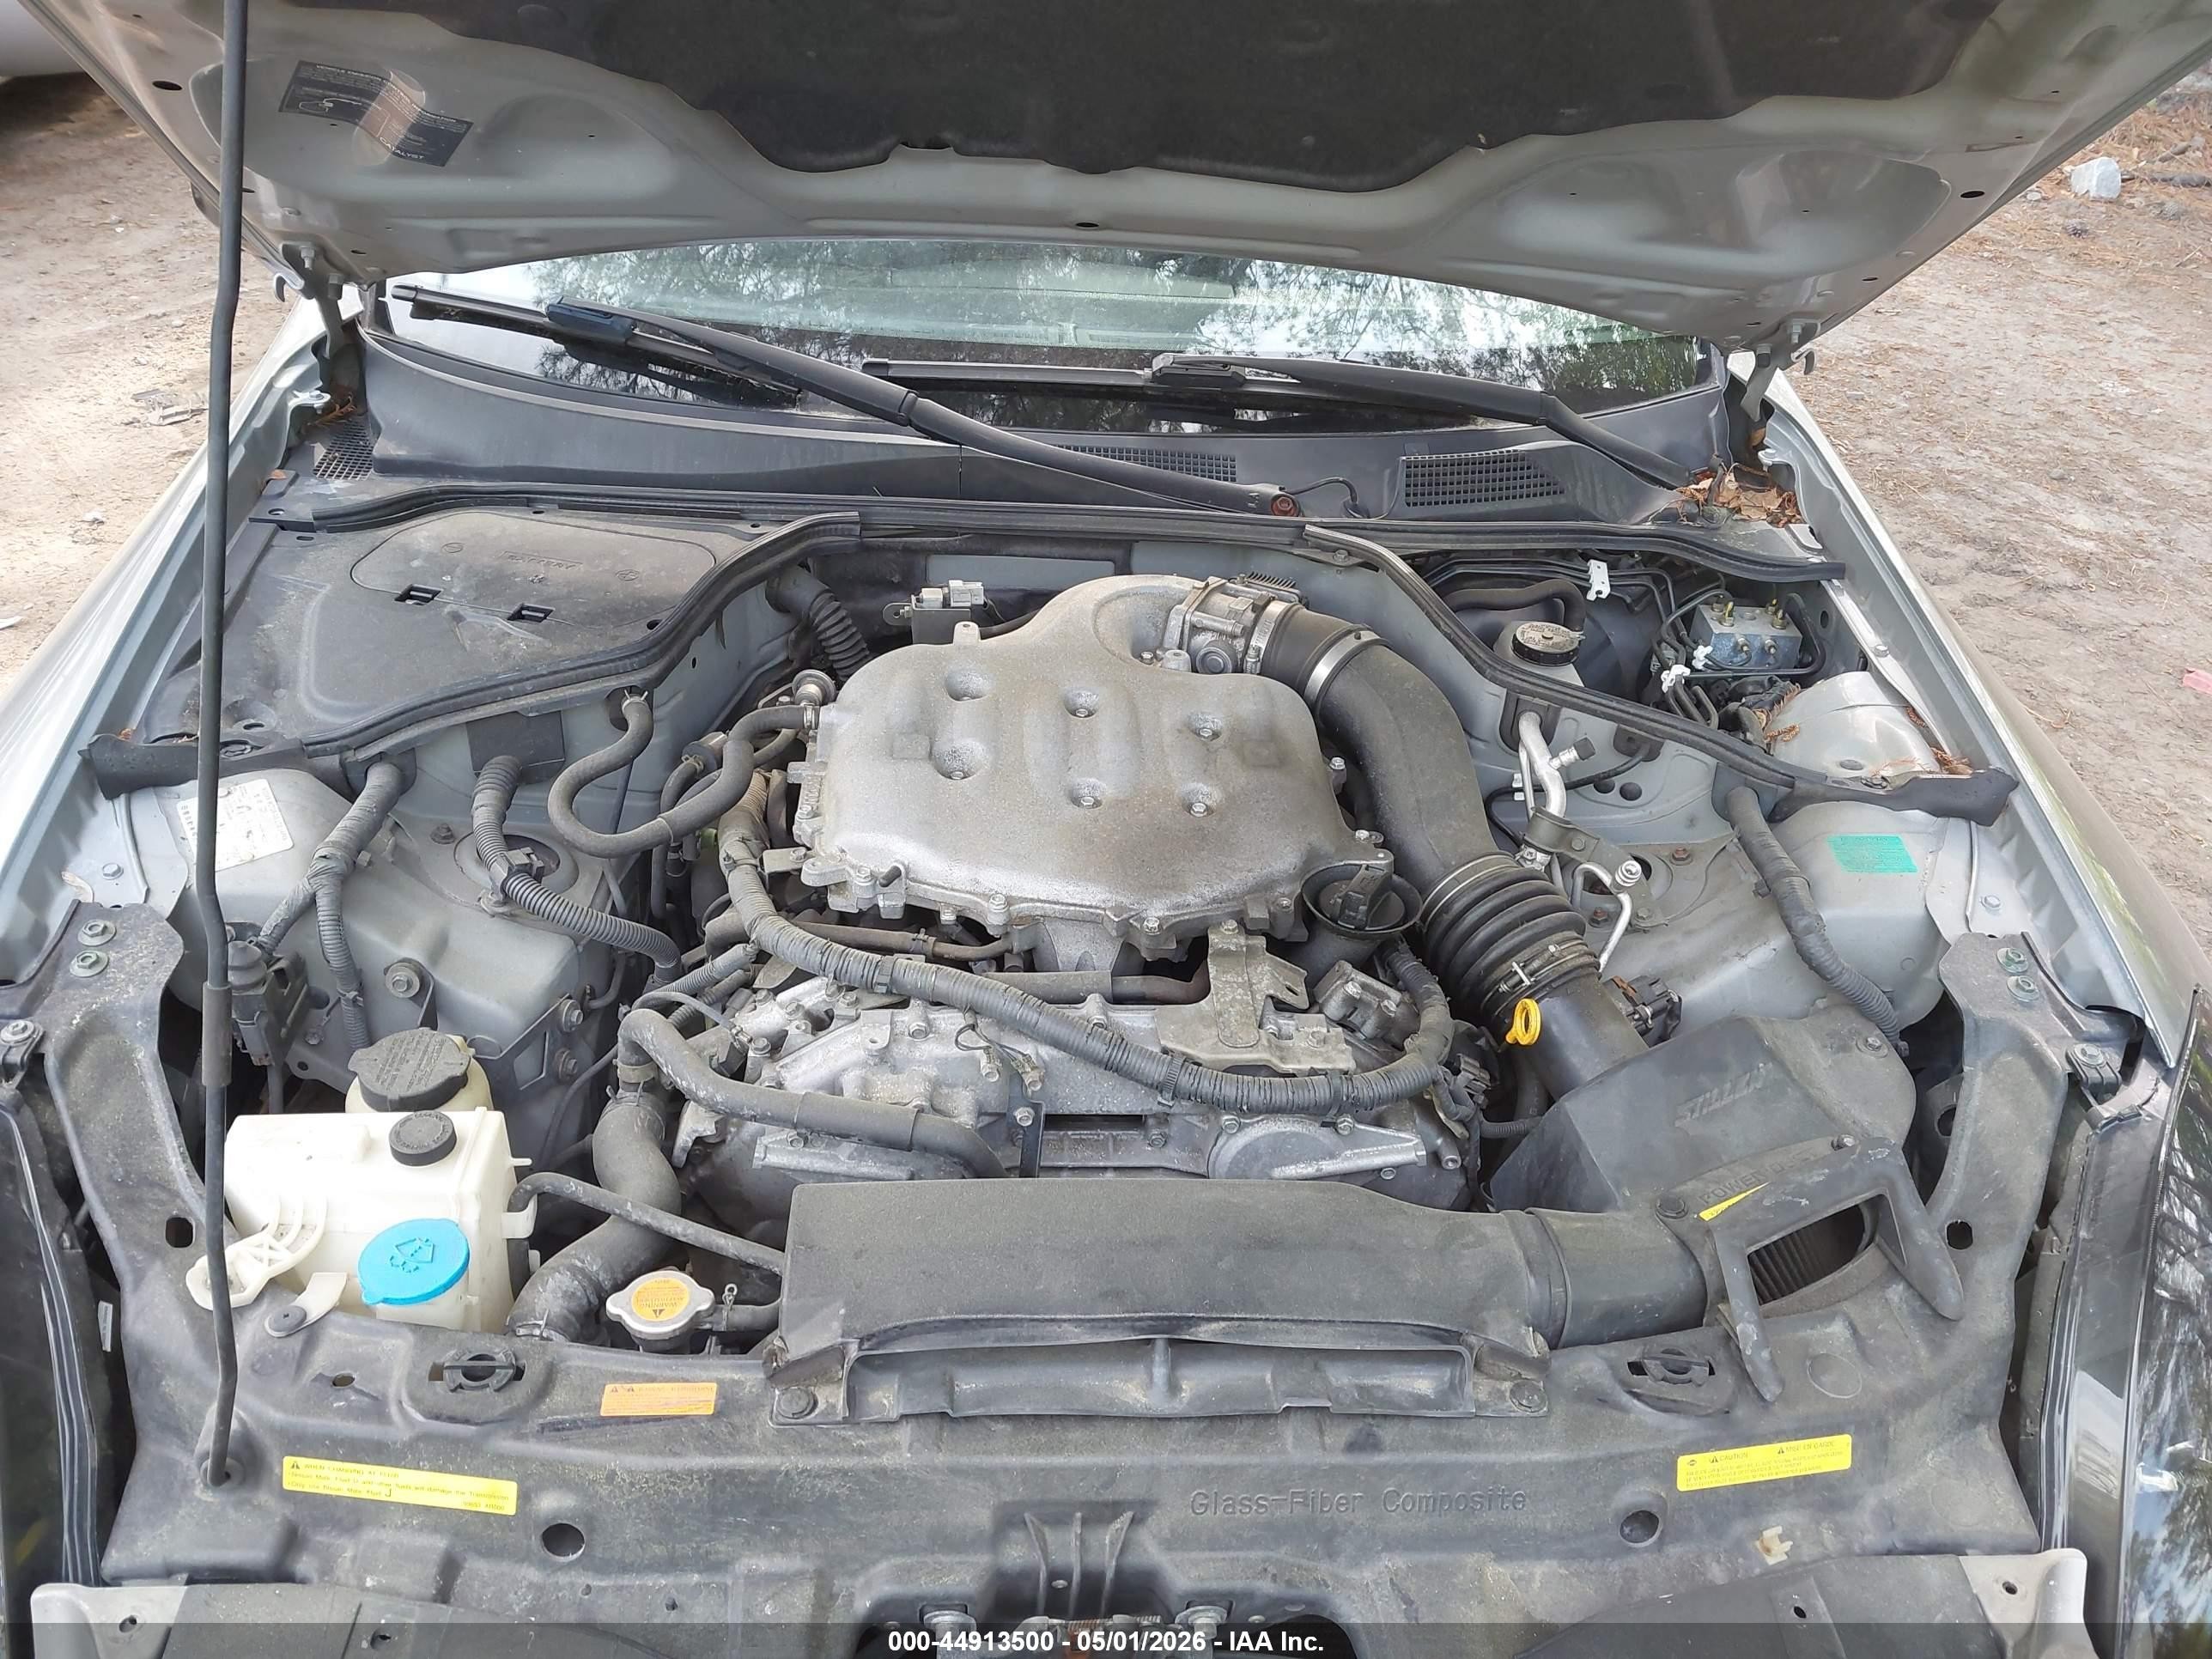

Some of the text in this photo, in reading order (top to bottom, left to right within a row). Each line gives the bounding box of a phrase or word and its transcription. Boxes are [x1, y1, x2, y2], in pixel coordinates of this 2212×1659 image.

[380, 137, 425, 160] CATALYST
[1719, 1451, 1748, 1462] CAUTION
[385, 1488, 392, 1498] J
[1191, 1484, 1527, 1517] Glass-Fiber Composite
